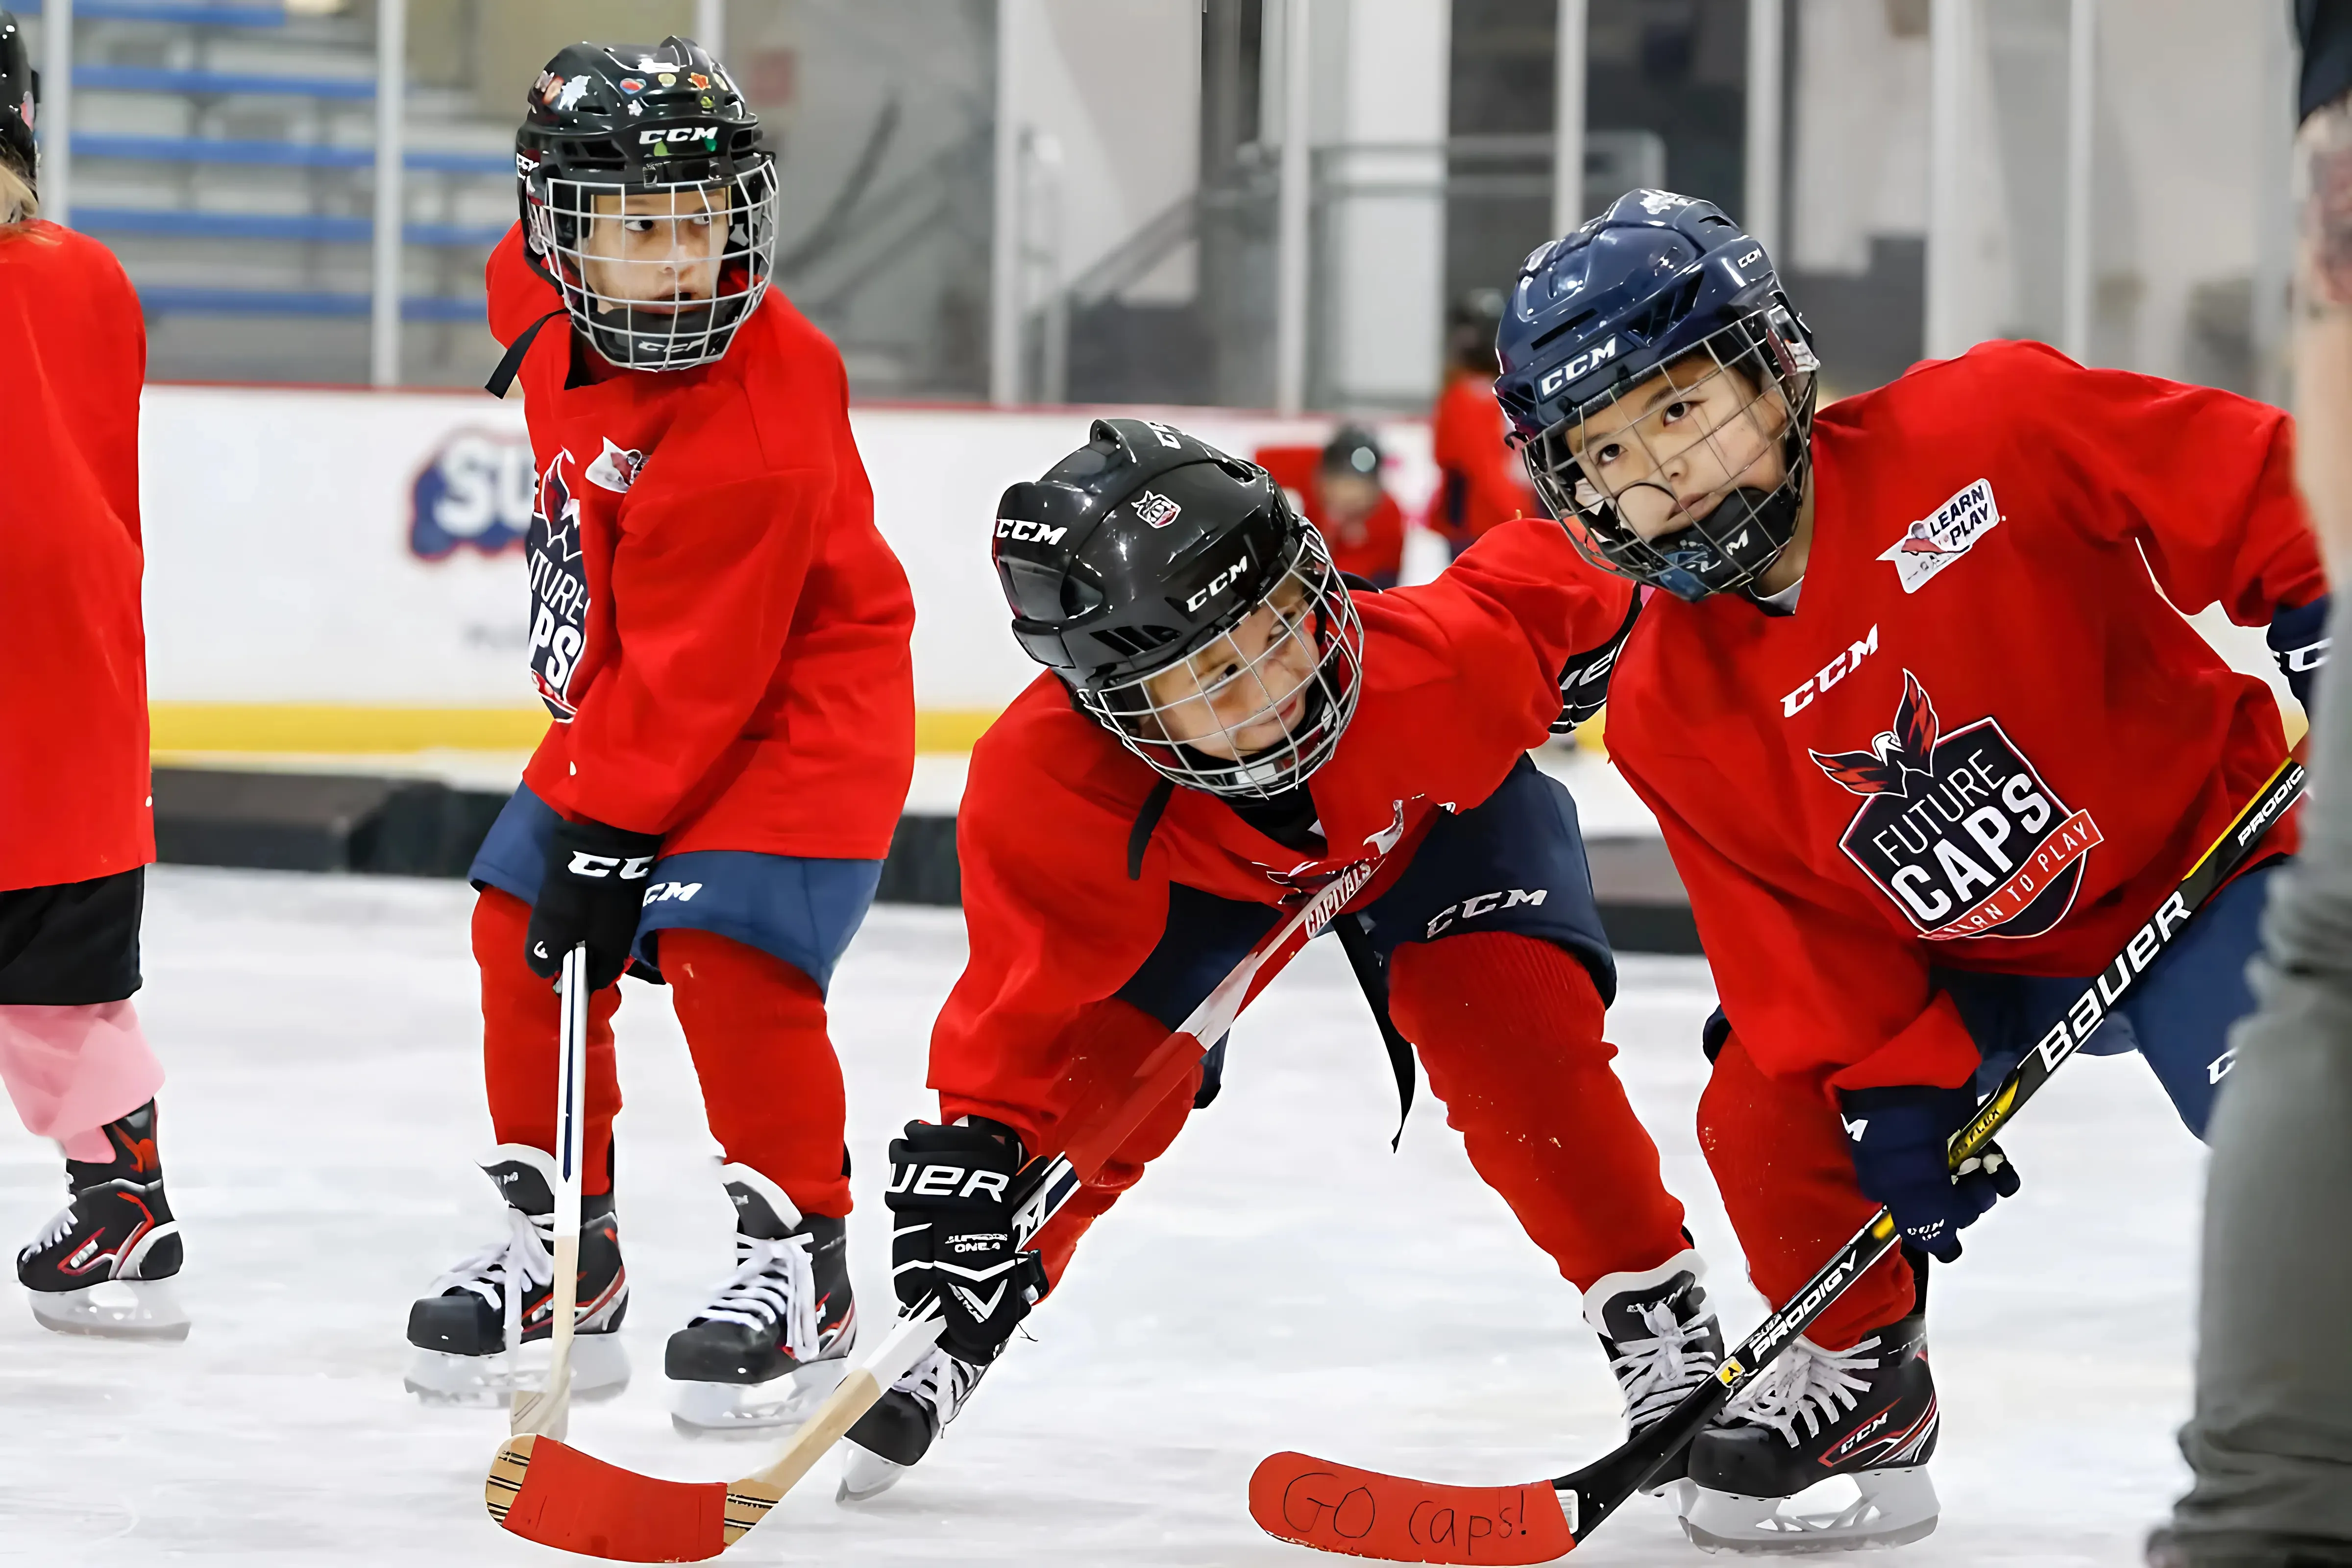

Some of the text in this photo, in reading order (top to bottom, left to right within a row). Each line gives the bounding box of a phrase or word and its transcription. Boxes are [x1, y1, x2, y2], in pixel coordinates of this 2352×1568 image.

[639, 126, 718, 144] CCM
[1541, 337, 1616, 396] CCM
[996, 518, 1068, 545] CCM
[1929, 485, 1985, 538] LEARN
[1949, 503, 1988, 546] PLAY
[1186, 555, 1248, 612] CCM
[1780, 623, 1879, 718] CCM
[1872, 748, 2007, 867] FUTURE
[1891, 773, 2052, 921] CAPS
[2037, 821, 2087, 872] PLAY
[1427, 888, 1548, 939] CCM
[2038, 890, 2192, 1073] BAUER
[1752, 1249, 1857, 1364] PRODIGY
[1283, 1471, 1375, 1539] GO
